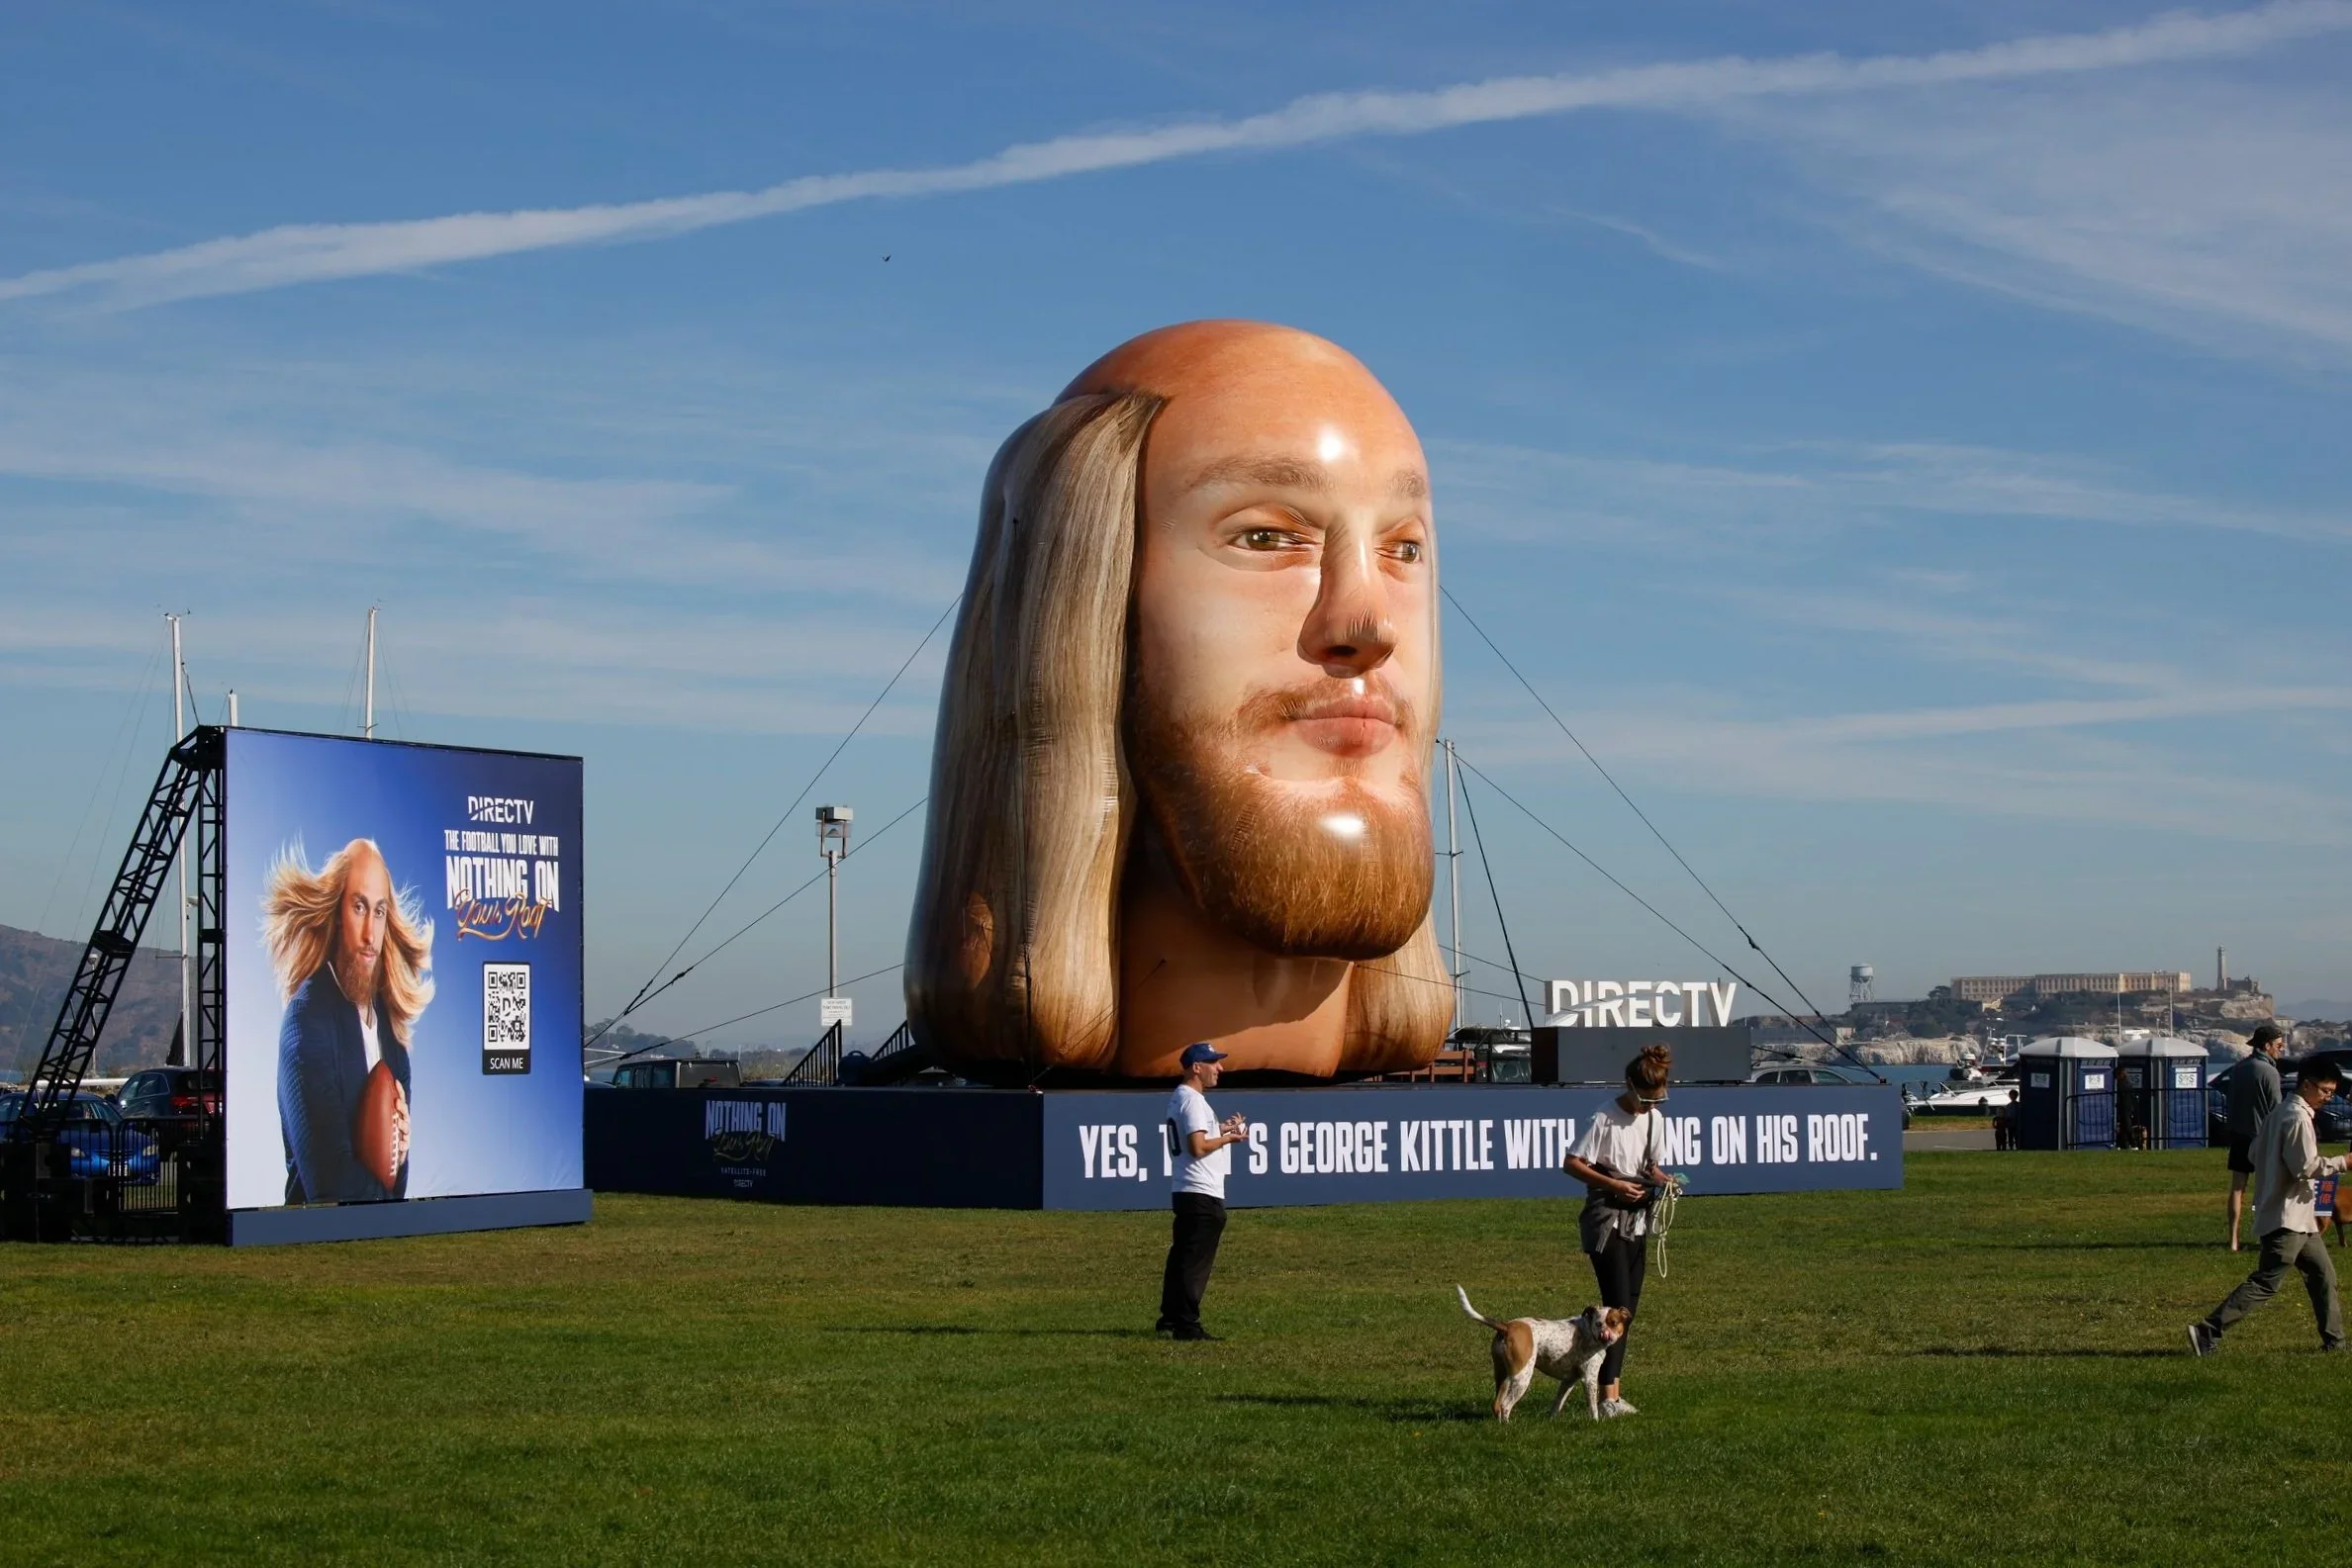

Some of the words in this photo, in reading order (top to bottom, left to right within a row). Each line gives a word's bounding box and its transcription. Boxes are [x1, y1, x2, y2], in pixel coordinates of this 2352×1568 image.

[468, 795, 534, 825] DIRECTV
[444, 829, 460, 851] THE
[461, 830, 501, 854] FOOTBALL
[501, 833, 517, 855] YOU
[518, 834, 537, 856] LOVE
[539, 836, 559, 857] WITH
[445, 856, 528, 910] NOTHING
[534, 861, 560, 913] ON
[1547, 980, 1738, 1027] DIRECTV
[490, 1058, 511, 1070] SCAN
[513, 1057, 523, 1069] ME
[705, 1099, 763, 1140] NOTHING
[767, 1101, 787, 1143] ON
[1079, 1124, 1148, 1182] YES,
[1279, 1121, 1389, 1175] GEORGE
[1400, 1120, 1494, 1172] KITTLE
[1504, 1118, 1575, 1170] WITH
[1711, 1115, 1747, 1165] ON
[1756, 1114, 1799, 1164] HIS
[1808, 1113, 1878, 1162] ROOF.
